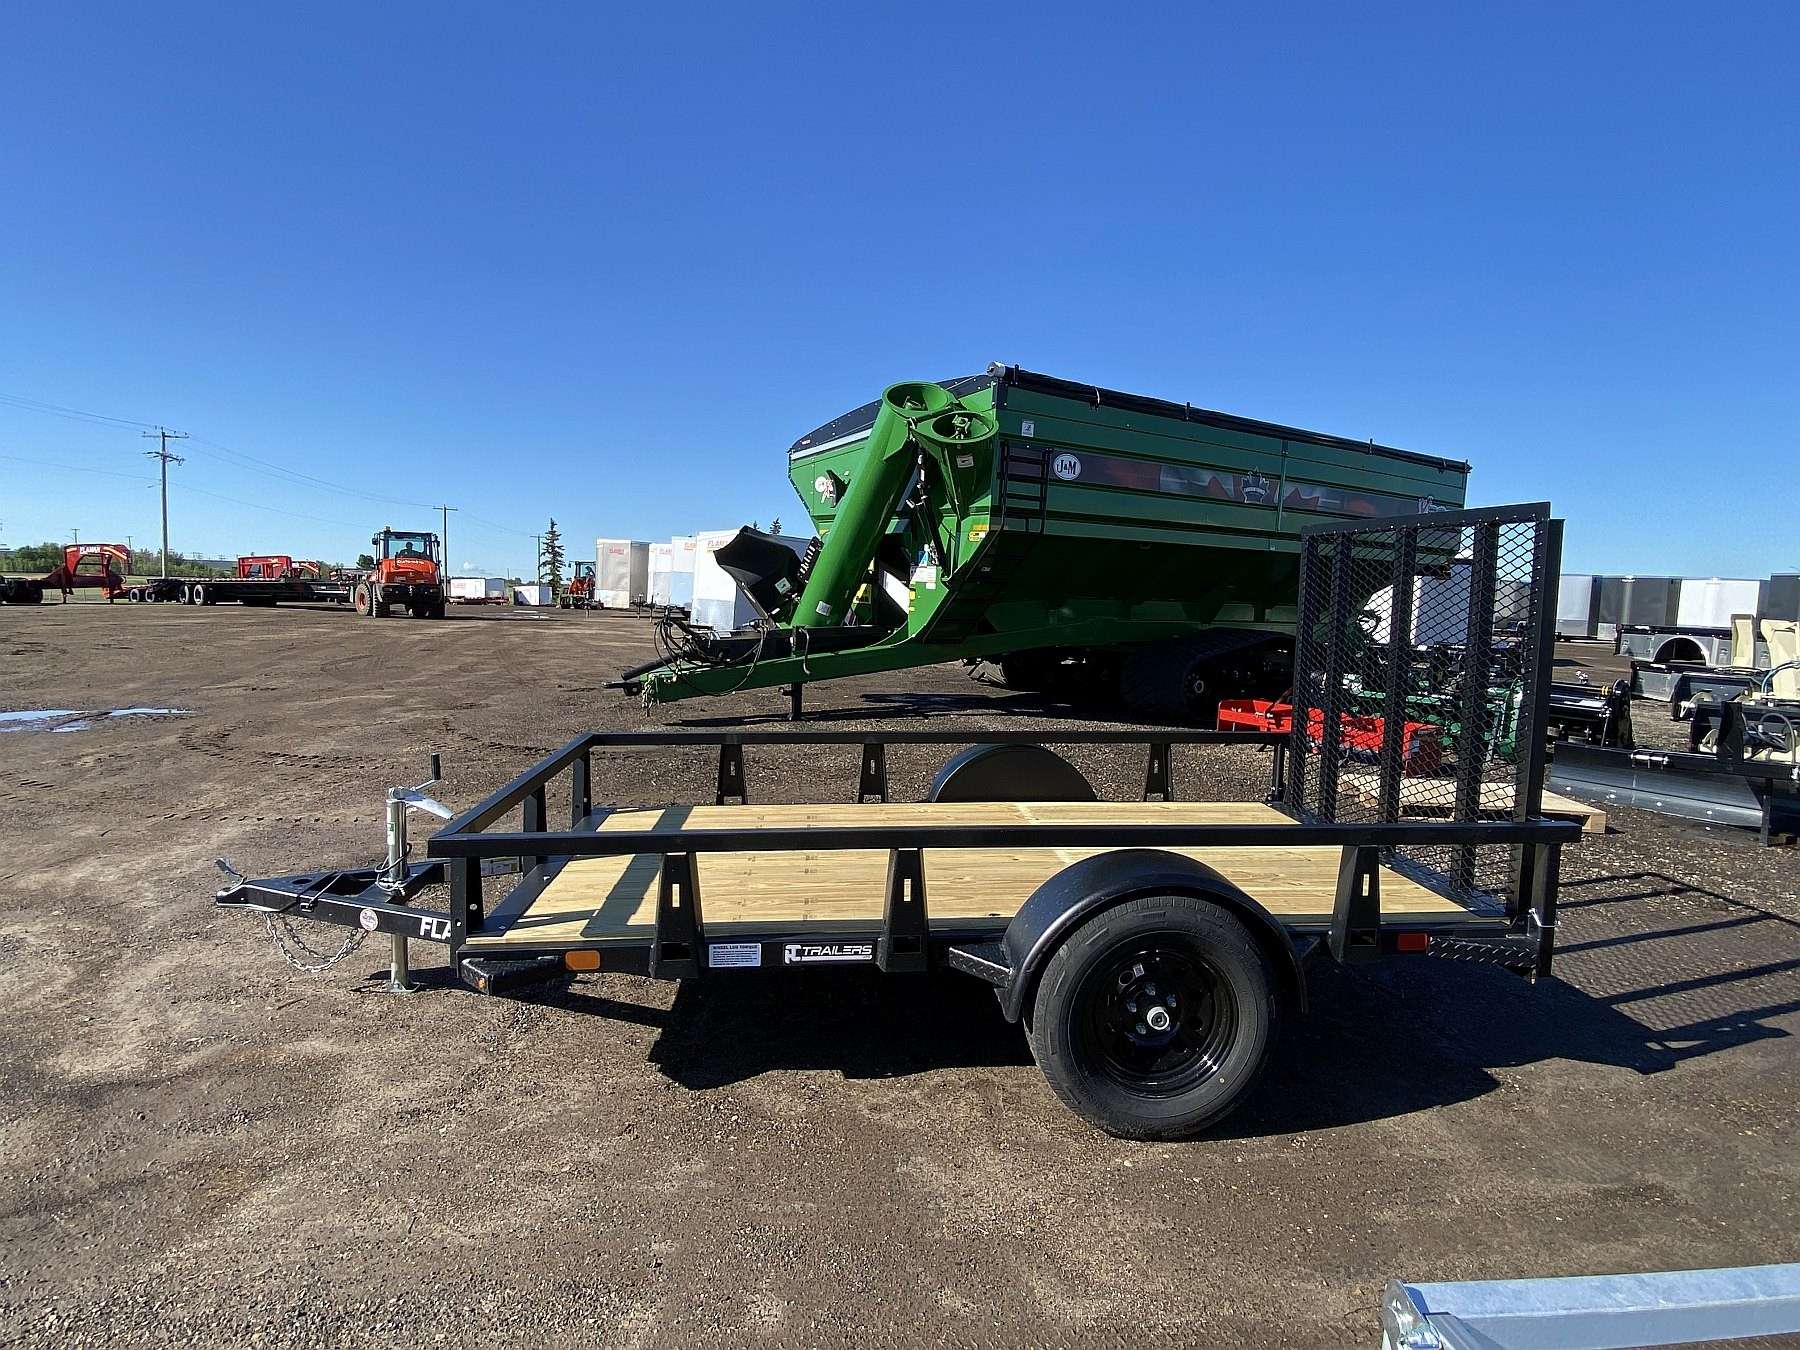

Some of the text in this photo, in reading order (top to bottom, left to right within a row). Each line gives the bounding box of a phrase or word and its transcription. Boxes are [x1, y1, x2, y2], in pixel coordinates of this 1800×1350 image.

[1056, 459, 1077, 475] J&M
[420, 917, 451, 939] FLA
[802, 945, 872, 955] TRAILERS
